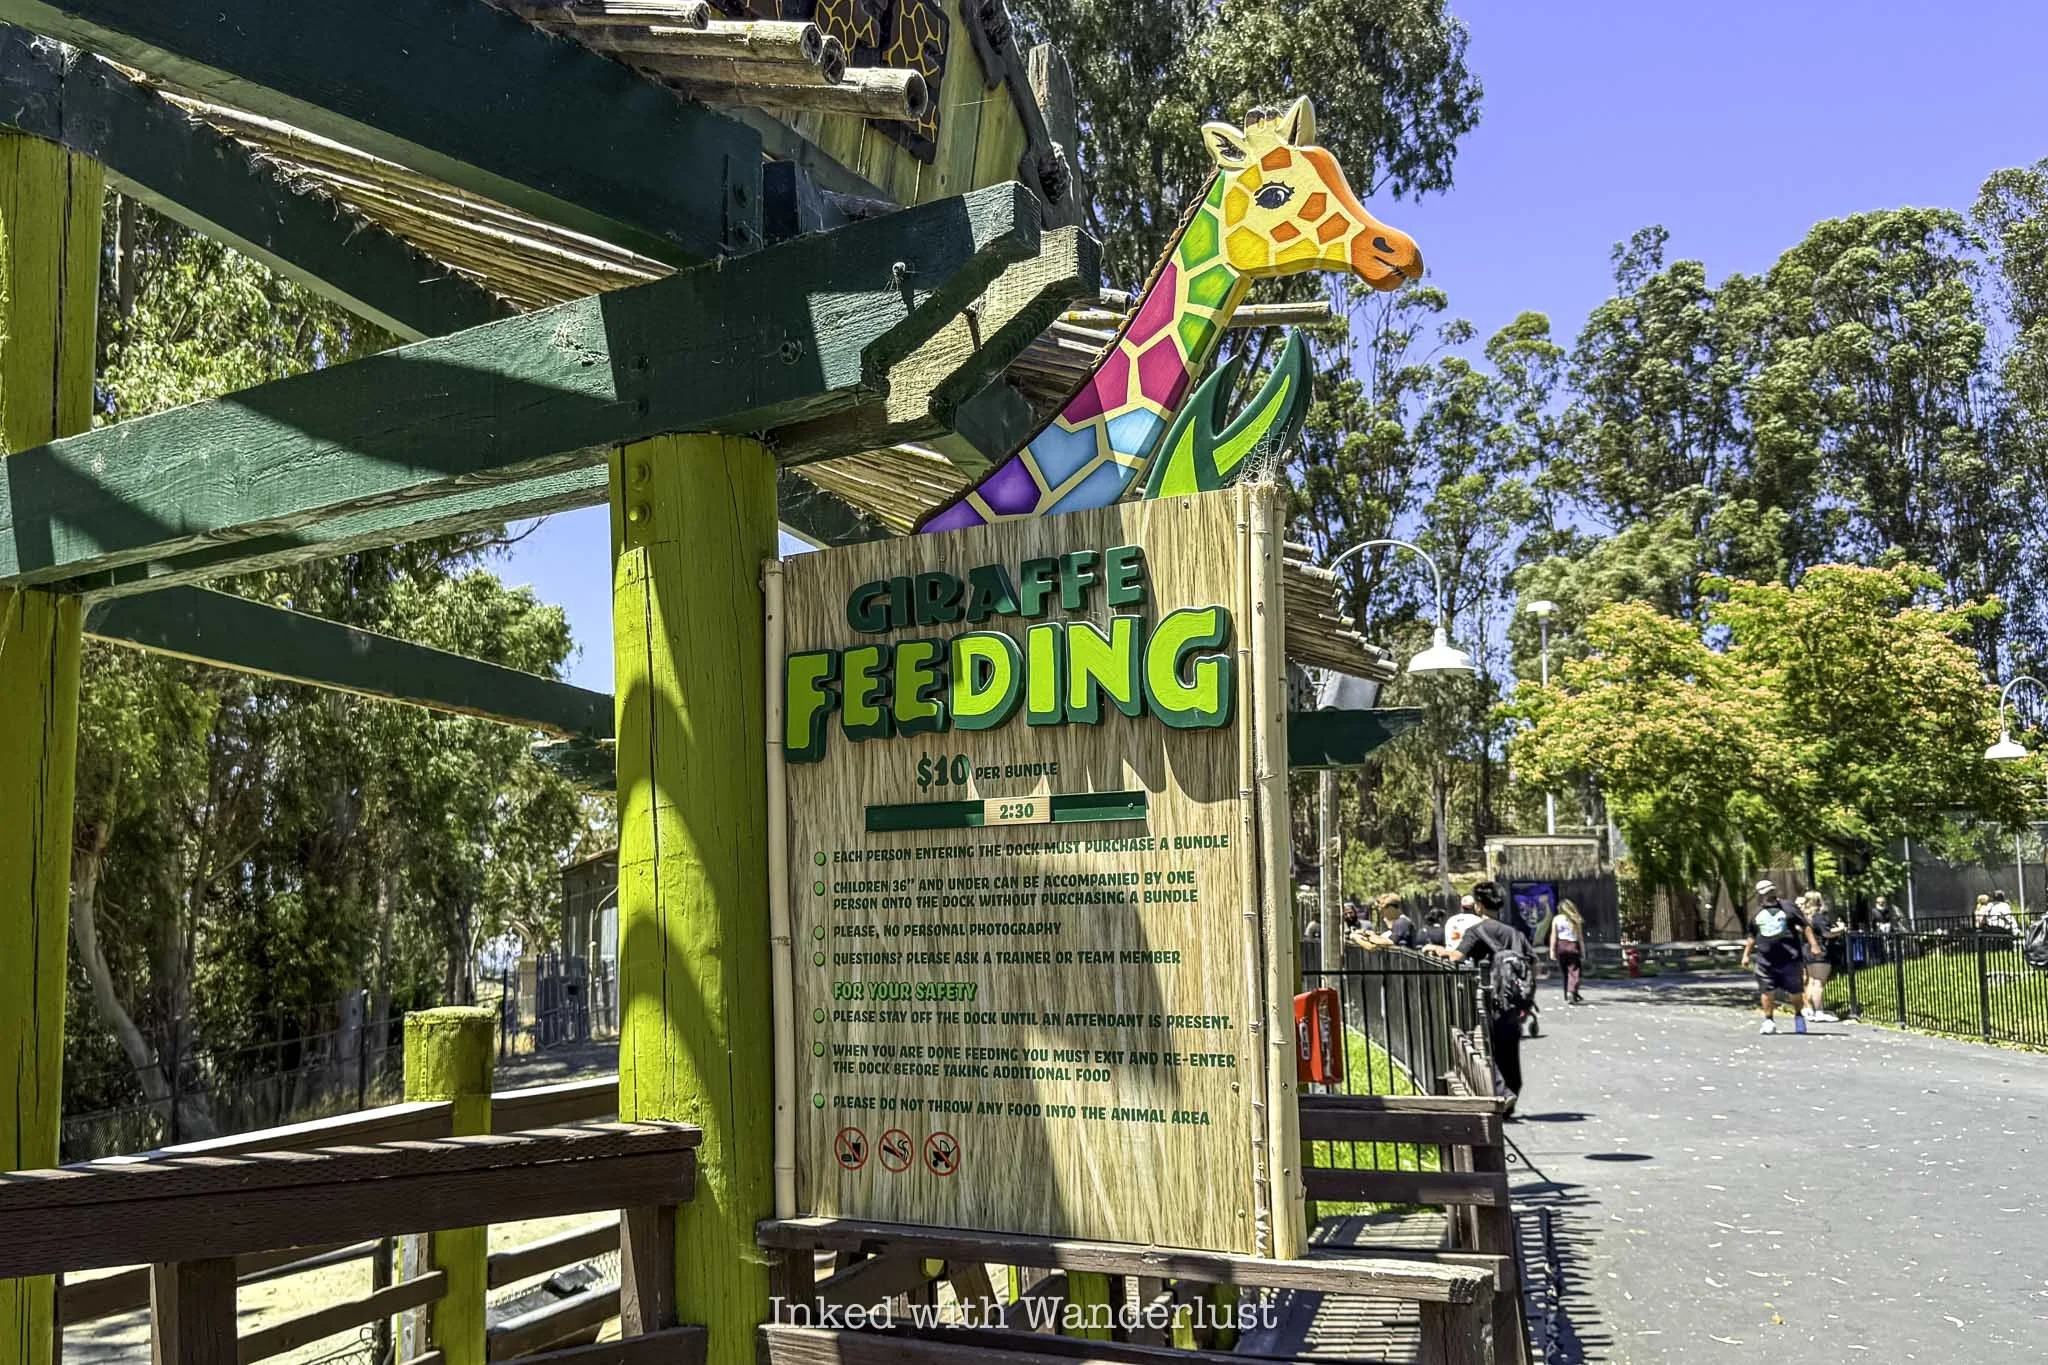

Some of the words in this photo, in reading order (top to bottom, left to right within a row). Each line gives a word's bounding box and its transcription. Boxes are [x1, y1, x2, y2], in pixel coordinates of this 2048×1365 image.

[846, 544, 1146, 634] GIRAFFE
[784, 605, 1236, 764] FEEDING
[917, 752, 970, 793] $10
[976, 766, 1000, 780] PER
[1005, 762, 1058, 778] BUNDLE
[1000, 803, 1034, 819] 2:30
[833, 851, 862, 863] EACH
[866, 848, 911, 862] PERSON
[916, 846, 974, 860] ENTERING
[979, 844, 1001, 857] THE
[1006, 844, 1039, 856] DOCK
[1044, 841, 1080, 854] MUST
[1085, 839, 1154, 853] PURCHASE
[1160, 837, 1169, 850] A
[1174, 835, 1228, 849] BUNDLE
[834, 881, 889, 893] CHILDREN
[919, 879, 943, 891] AND
[950, 878, 989, 890] UNDER
[994, 877, 1021, 889] CAN
[1024, 876, 1039, 888] BE
[1044, 872, 1139, 888] ACCOMPANIED
[1145, 872, 1162, 885] BY
[1167, 871, 1195, 884] ONE
[833, 897, 878, 910] PERSON
[882, 896, 912, 909] ONTO
[916, 895, 938, 908] THE
[943, 895, 975, 908] DOCK
[979, 893, 1037, 907] WITHOUT
[1041, 891, 1124, 905] PURCHASING
[1130, 891, 1139, 904] A
[1145, 890, 1197, 903] BUNDLE
[834, 925, 879, 939] PLEASE,
[884, 925, 899, 937] NO
[904, 924, 965, 937] PERSONAL
[970, 922, 1061, 936] PHOTOGRAPHY
[833, 952, 902, 966] QUESTIONS?
[907, 952, 950, 964] PLEASE
[955, 952, 978, 964] ASK
[983, 952, 991, 964] A
[997, 951, 1050, 964] TRAINER
[1056, 951, 1072, 964] OR
[1077, 951, 1114, 964] TEAM
[1120, 951, 1180, 964] MEMBER
[833, 982, 864, 1000] FOR
[868, 982, 912, 1000] YOUR
[915, 982, 977, 1001] SAFETY
[833, 1011, 875, 1023] PLEASE
[879, 1011, 907, 1023] STAY
[911, 1011, 932, 1024] OFF
[937, 1012, 958, 1024] THE
[964, 1012, 996, 1024] DOCK
[1001, 1013, 1038, 1025] UNTIL
[1042, 1013, 1063, 1026] AN
[1066, 1014, 1143, 1028] ATTENDANT
[1149, 1015, 1161, 1028] IS
[1167, 1015, 1234, 1030] PRESENT.
[833, 1045, 868, 1056] WHEN
[872, 1045, 895, 1058] YOU
[900, 1046, 923, 1058] ARE
[928, 1047, 960, 1059] DONE
[965, 1047, 1018, 1061] FEEDING
[1023, 1049, 1048, 1062] YOU
[1053, 1050, 1090, 1063] MUST
[1095, 1051, 1124, 1065] EXIT
[1129, 1052, 1158, 1065] AND
[1164, 1053, 1235, 1068] RE-ENTER
[833, 1062, 854, 1073] THE
[859, 1062, 889, 1074] DOCK
[894, 1063, 939, 1076] BEFORE
[944, 1065, 988, 1078] TAKING
[993, 1067, 1071, 1080] ADDITIONAL
[1076, 1069, 1110, 1082] FOOD
[834, 1096, 875, 1109] PLEASE
[880, 1097, 896, 1110] DO
[900, 1098, 923, 1111] NOT
[928, 1100, 973, 1114] THROW
[977, 1102, 1003, 1115] ANY
[1008, 1103, 1041, 1116] FOOD
[1046, 1104, 1076, 1118] INTO
[1081, 1106, 1106, 1120] THE
[1111, 1108, 1166, 1122] ANIMAL
[1172, 1110, 1210, 1125] AREA
